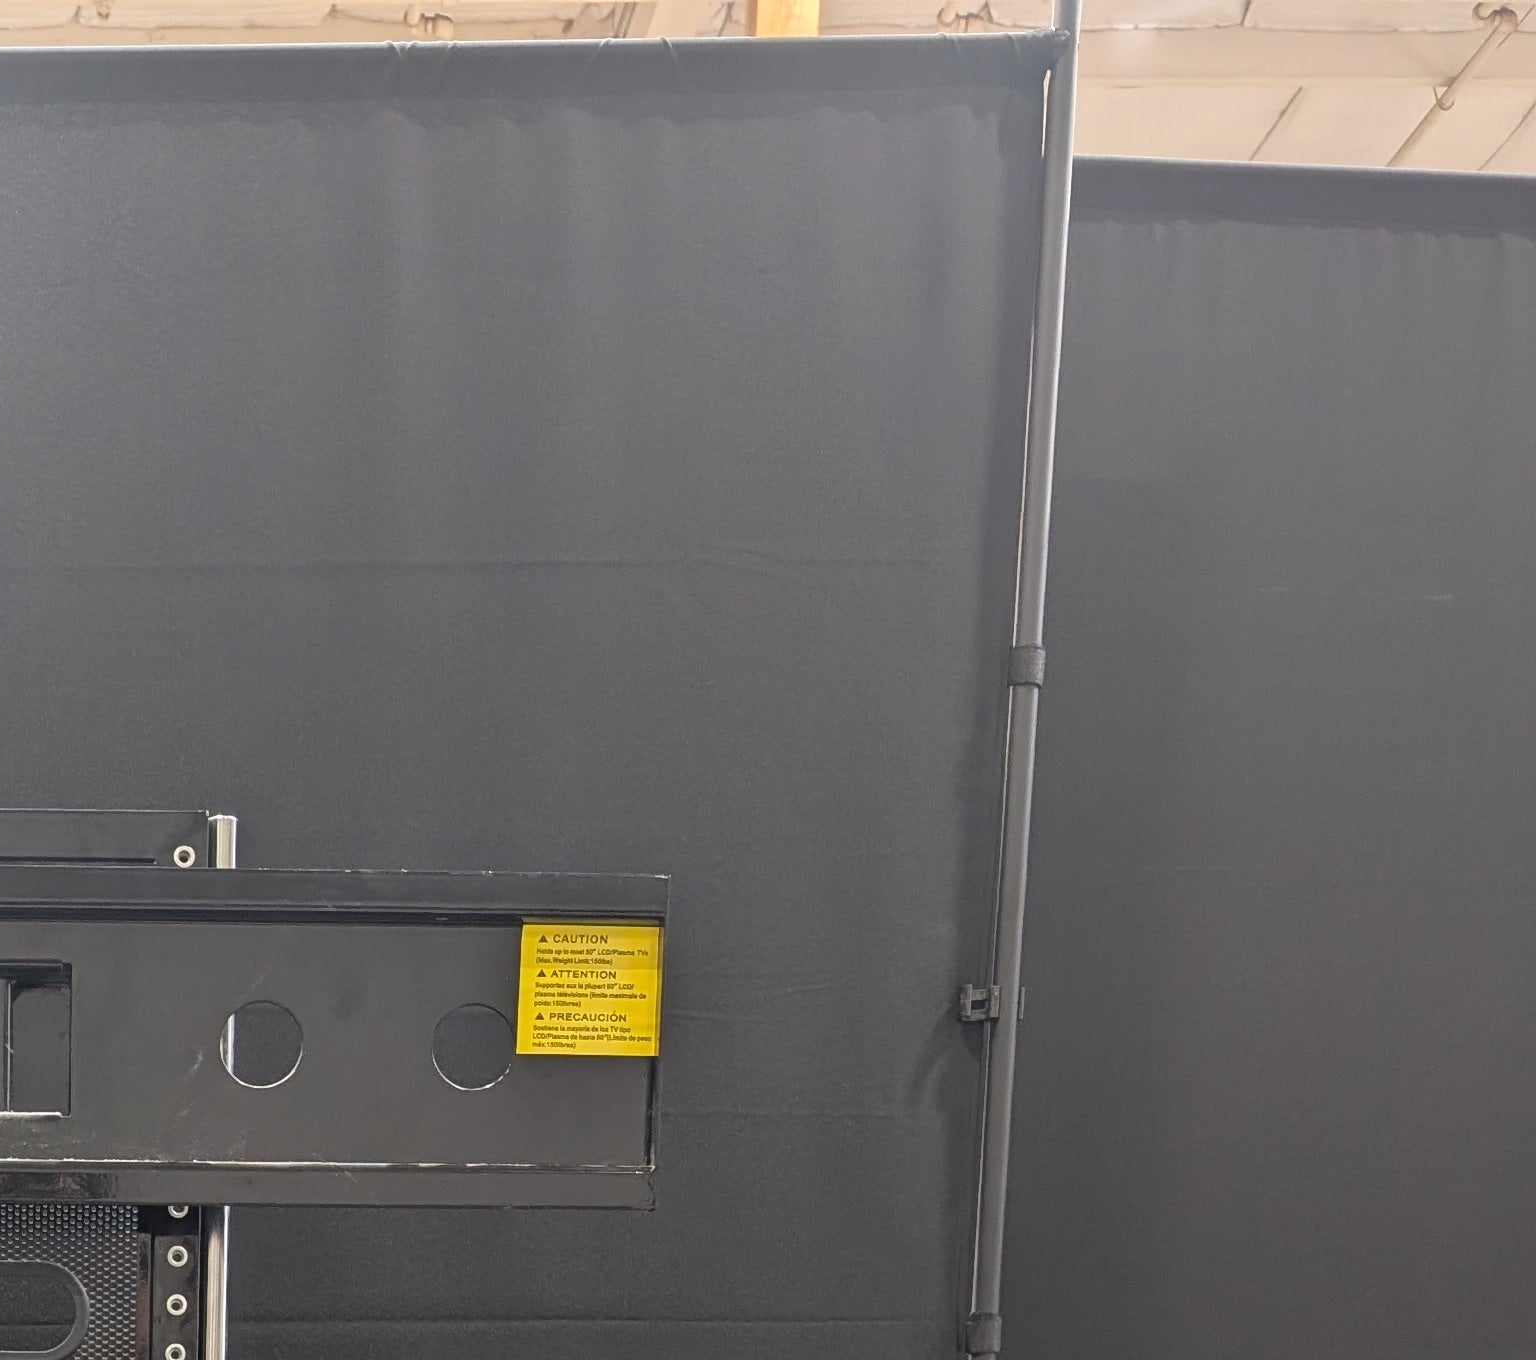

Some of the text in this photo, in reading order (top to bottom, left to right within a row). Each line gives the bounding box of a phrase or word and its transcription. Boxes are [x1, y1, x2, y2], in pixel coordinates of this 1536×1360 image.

[553, 934, 609, 944] CAUTION
[550, 969, 617, 979] ATTENTION
[618, 983, 635, 991] LCD/
[549, 1010, 627, 1023] PRECAUCIÓN
[619, 1026, 631, 1034] tipo
